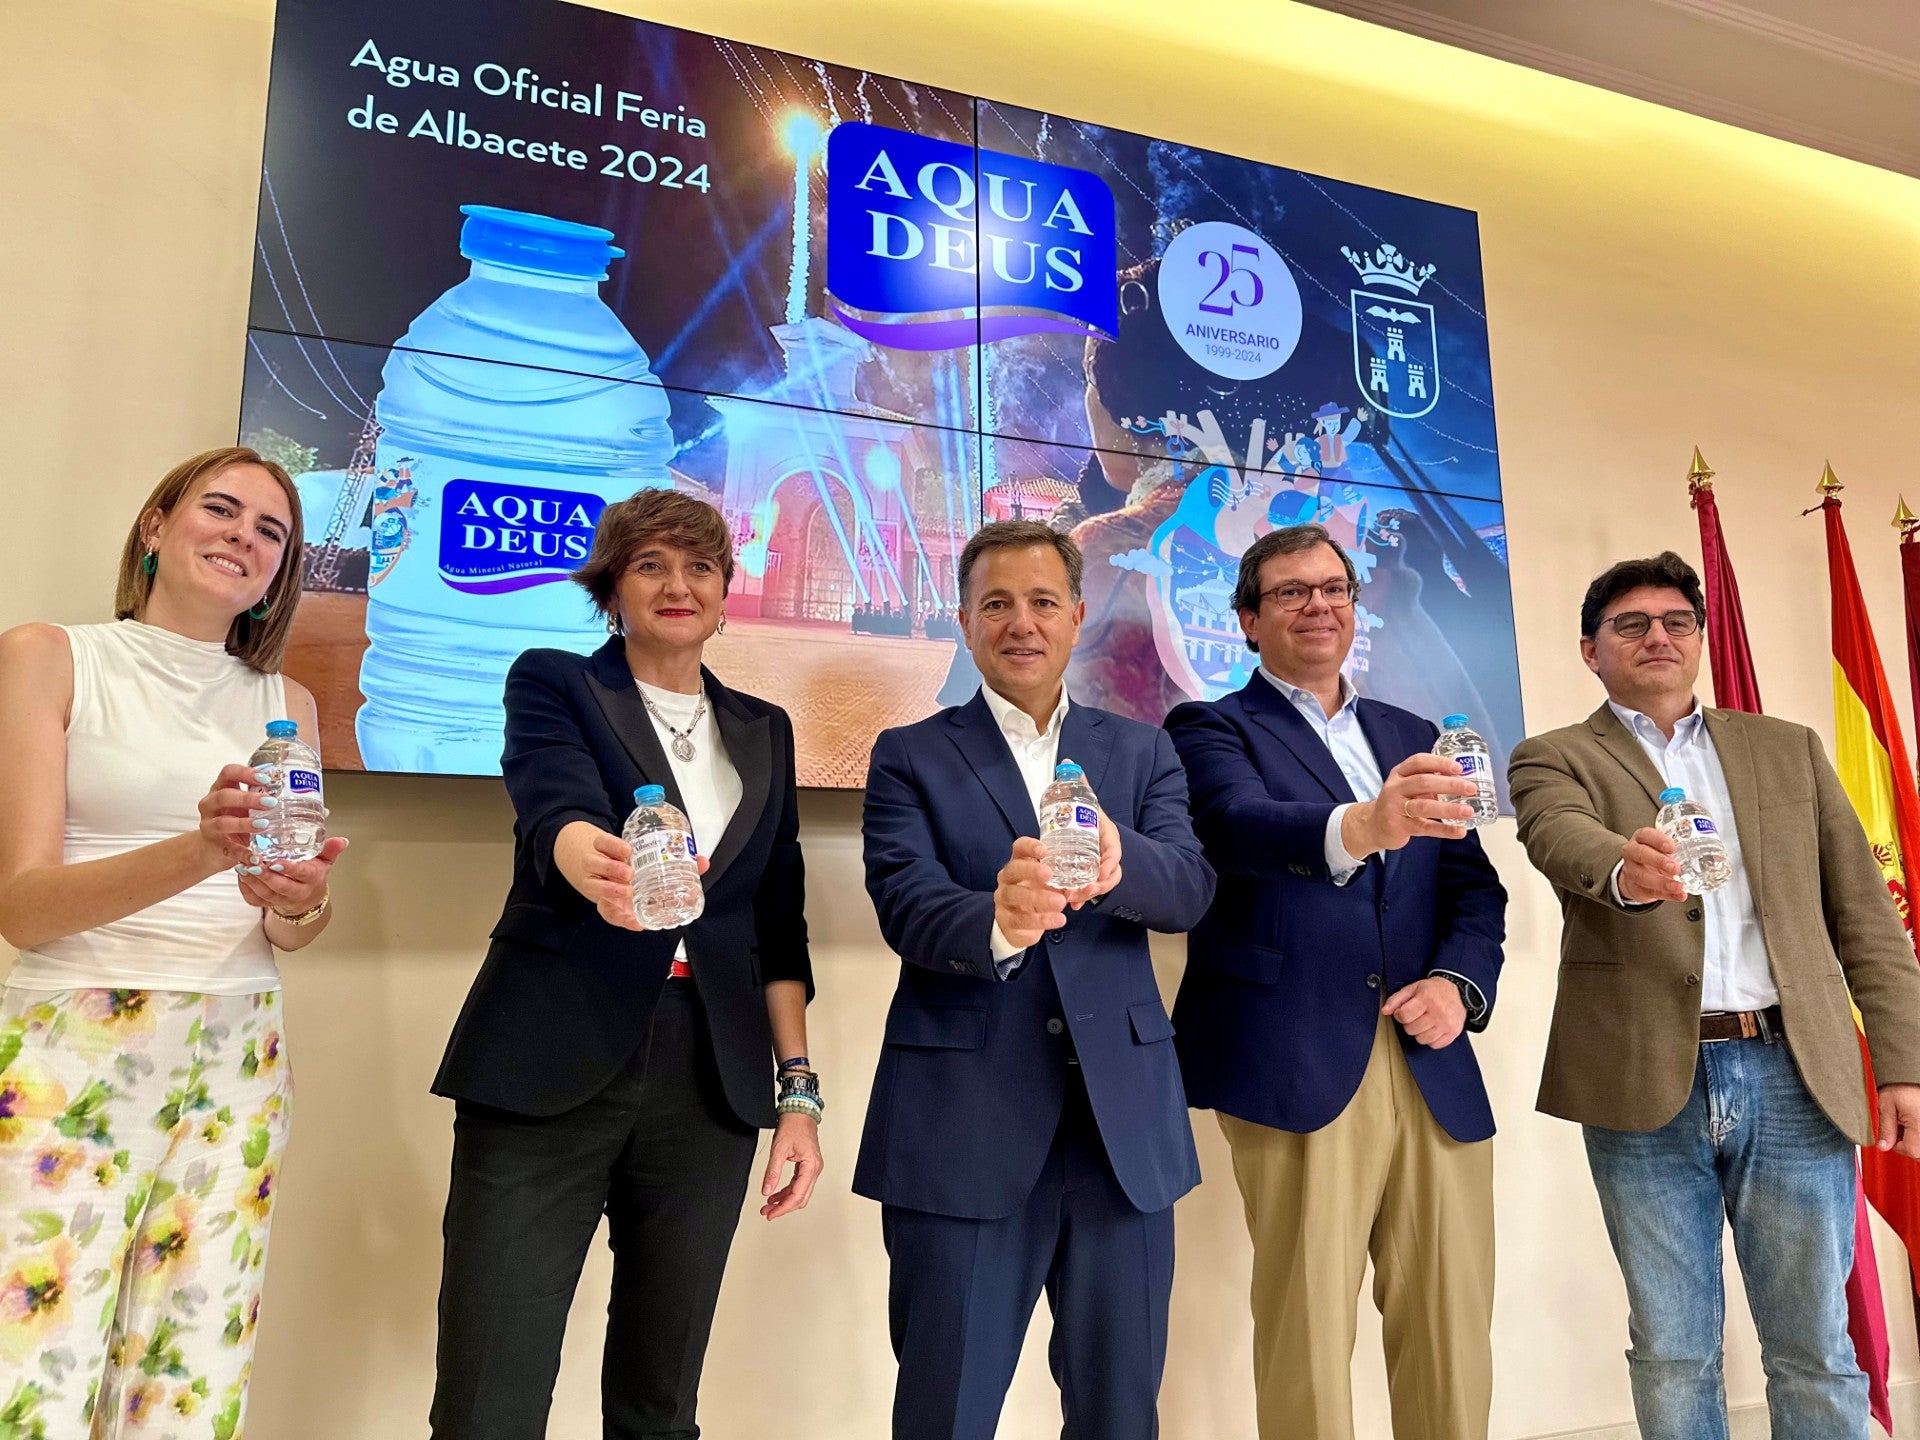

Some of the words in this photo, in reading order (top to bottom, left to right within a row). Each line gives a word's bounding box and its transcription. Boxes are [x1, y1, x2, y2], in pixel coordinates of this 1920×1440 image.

[350, 39, 460, 88] Agua
[473, 63, 602, 117] Oficial
[617, 91, 706, 138] Feria
[347, 94, 399, 134] de
[407, 109, 588, 170] Albacete
[600, 144, 711, 193] 2024
[854, 149, 1094, 236] AQUA
[865, 209, 1084, 292] DEUS
[1198, 243, 1264, 316] 25
[1186, 323, 1280, 350] ANIVERSARIO
[1205, 344, 1262, 363] 1999-2024
[457, 492, 596, 529] AQUA
[444, 563, 466, 575] Agua
[469, 564, 505, 575] Mineral
[508, 559, 543, 570] Natural
[461, 524, 588, 560] DEUS
